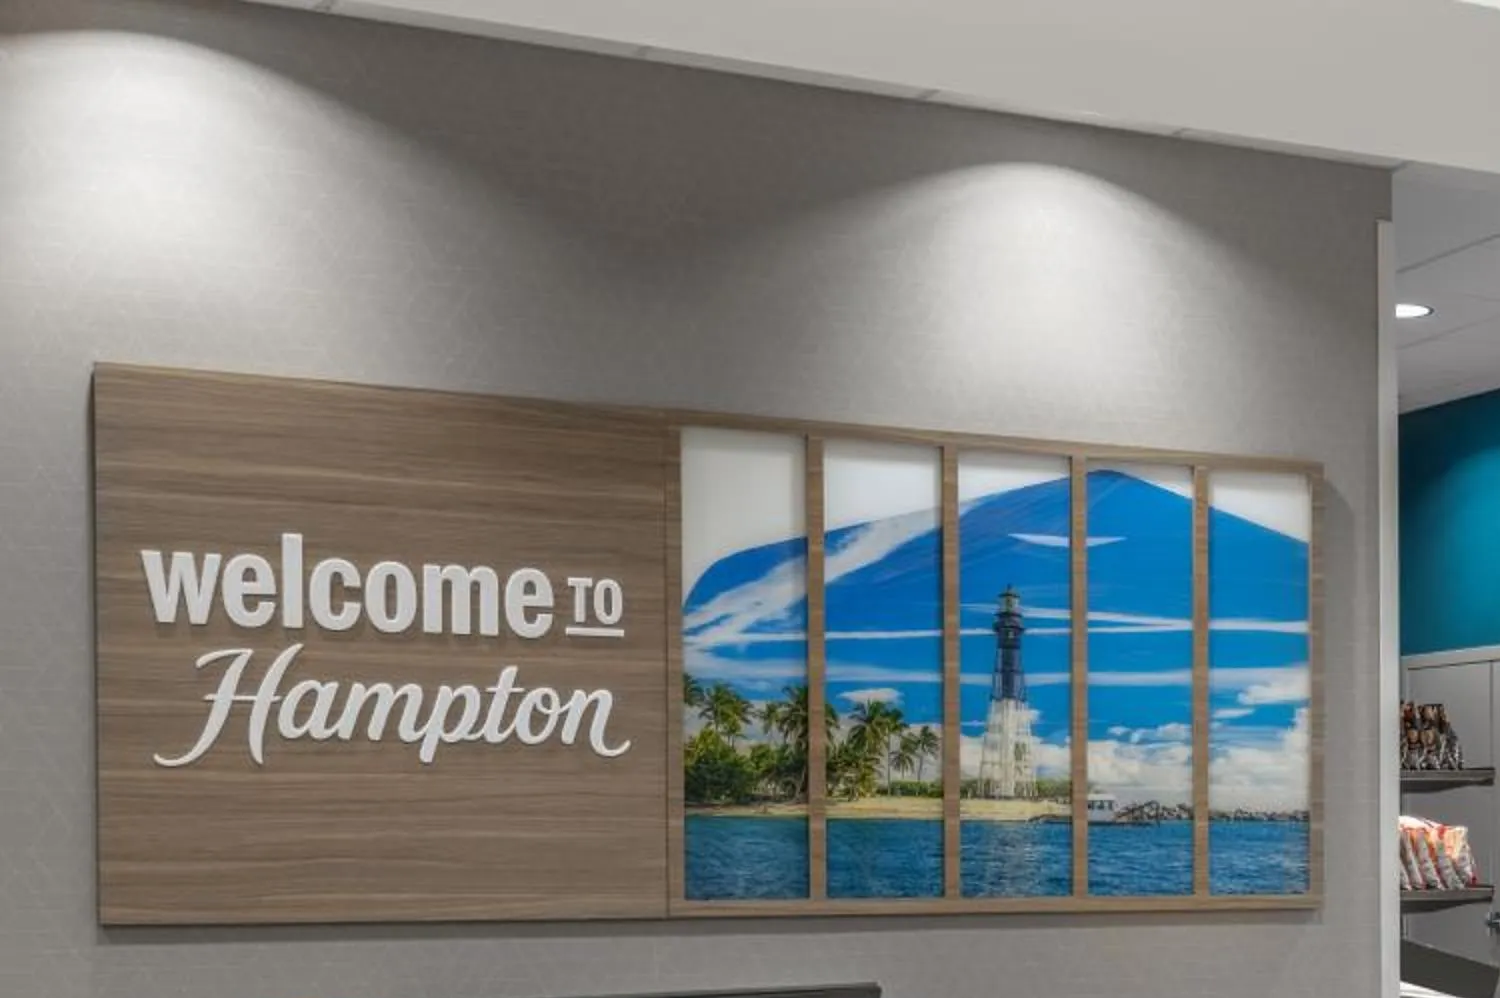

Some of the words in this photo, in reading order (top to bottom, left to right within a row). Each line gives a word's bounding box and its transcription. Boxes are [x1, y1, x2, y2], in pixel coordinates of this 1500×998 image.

[140, 533, 555, 638] welcome
[566, 577, 624, 626] TO
[153, 643, 632, 767] Hampton
